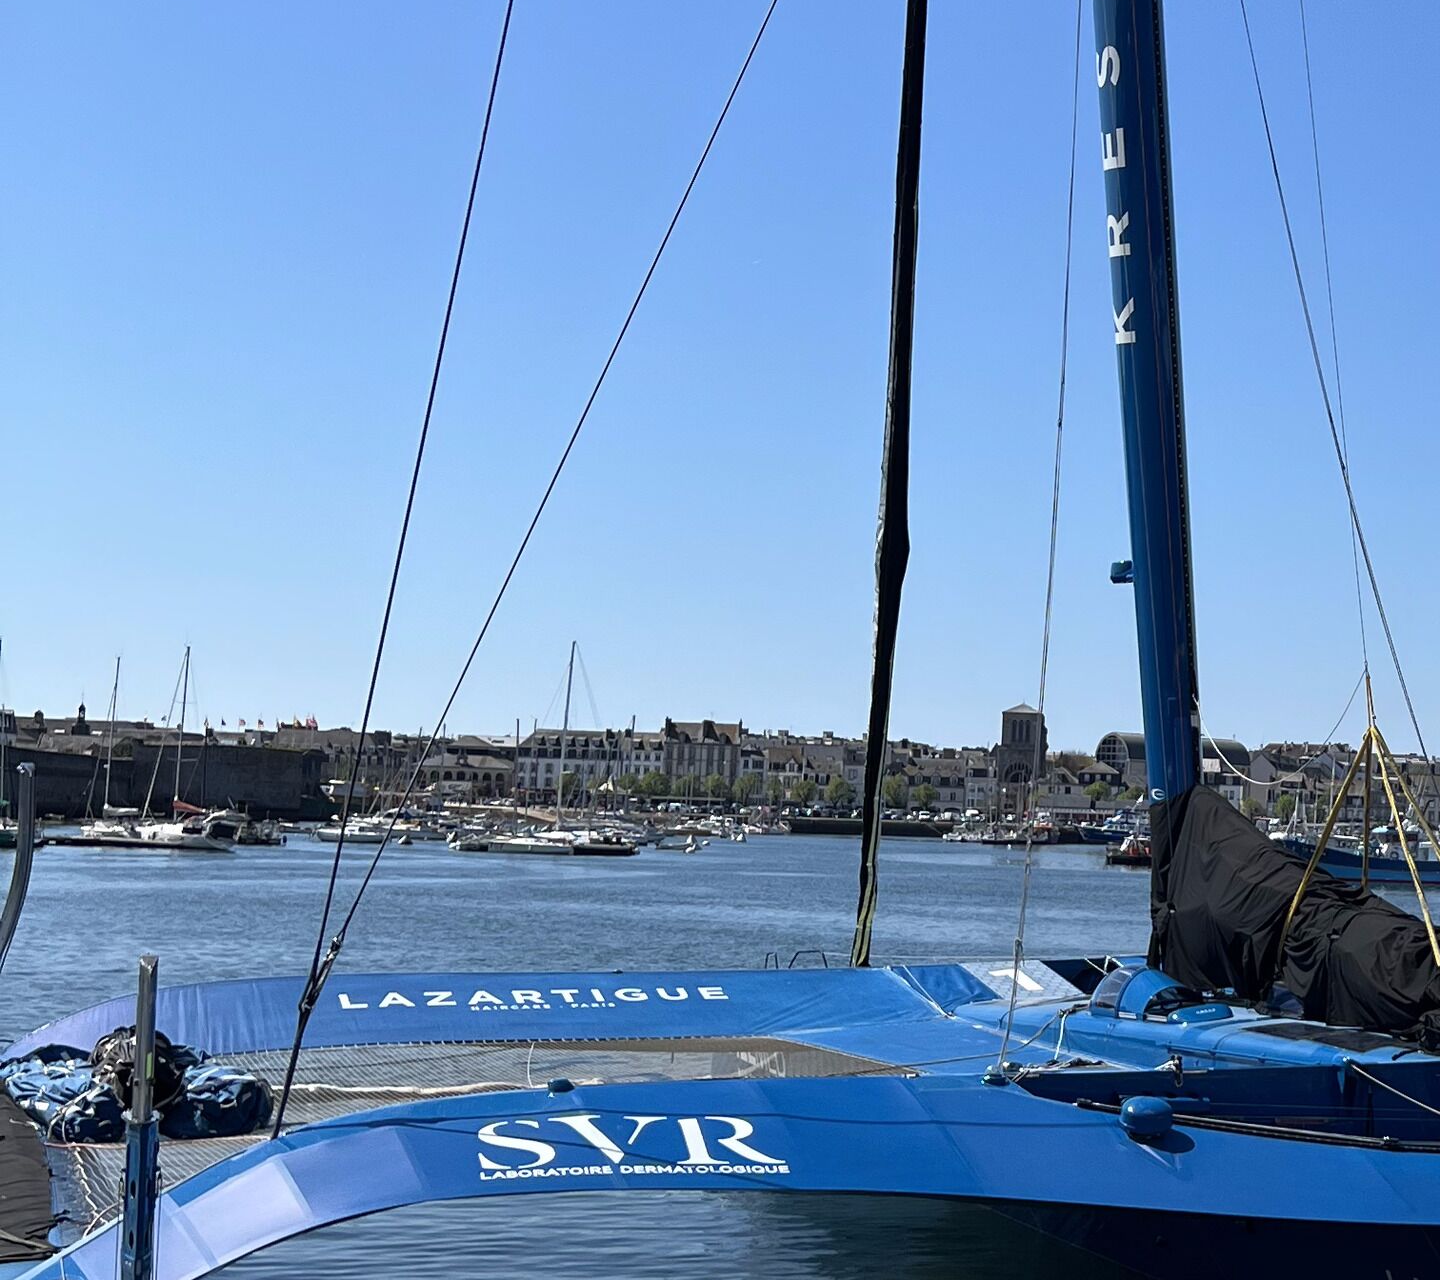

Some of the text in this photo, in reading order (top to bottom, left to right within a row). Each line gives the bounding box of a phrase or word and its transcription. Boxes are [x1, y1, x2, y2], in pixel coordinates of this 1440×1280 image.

[338, 986, 729, 1009] LAZARTIGUE
[477, 1115, 787, 1170] SVR
[479, 1163, 790, 1181] LABORATOIRE DERMATOLOGIQUE
